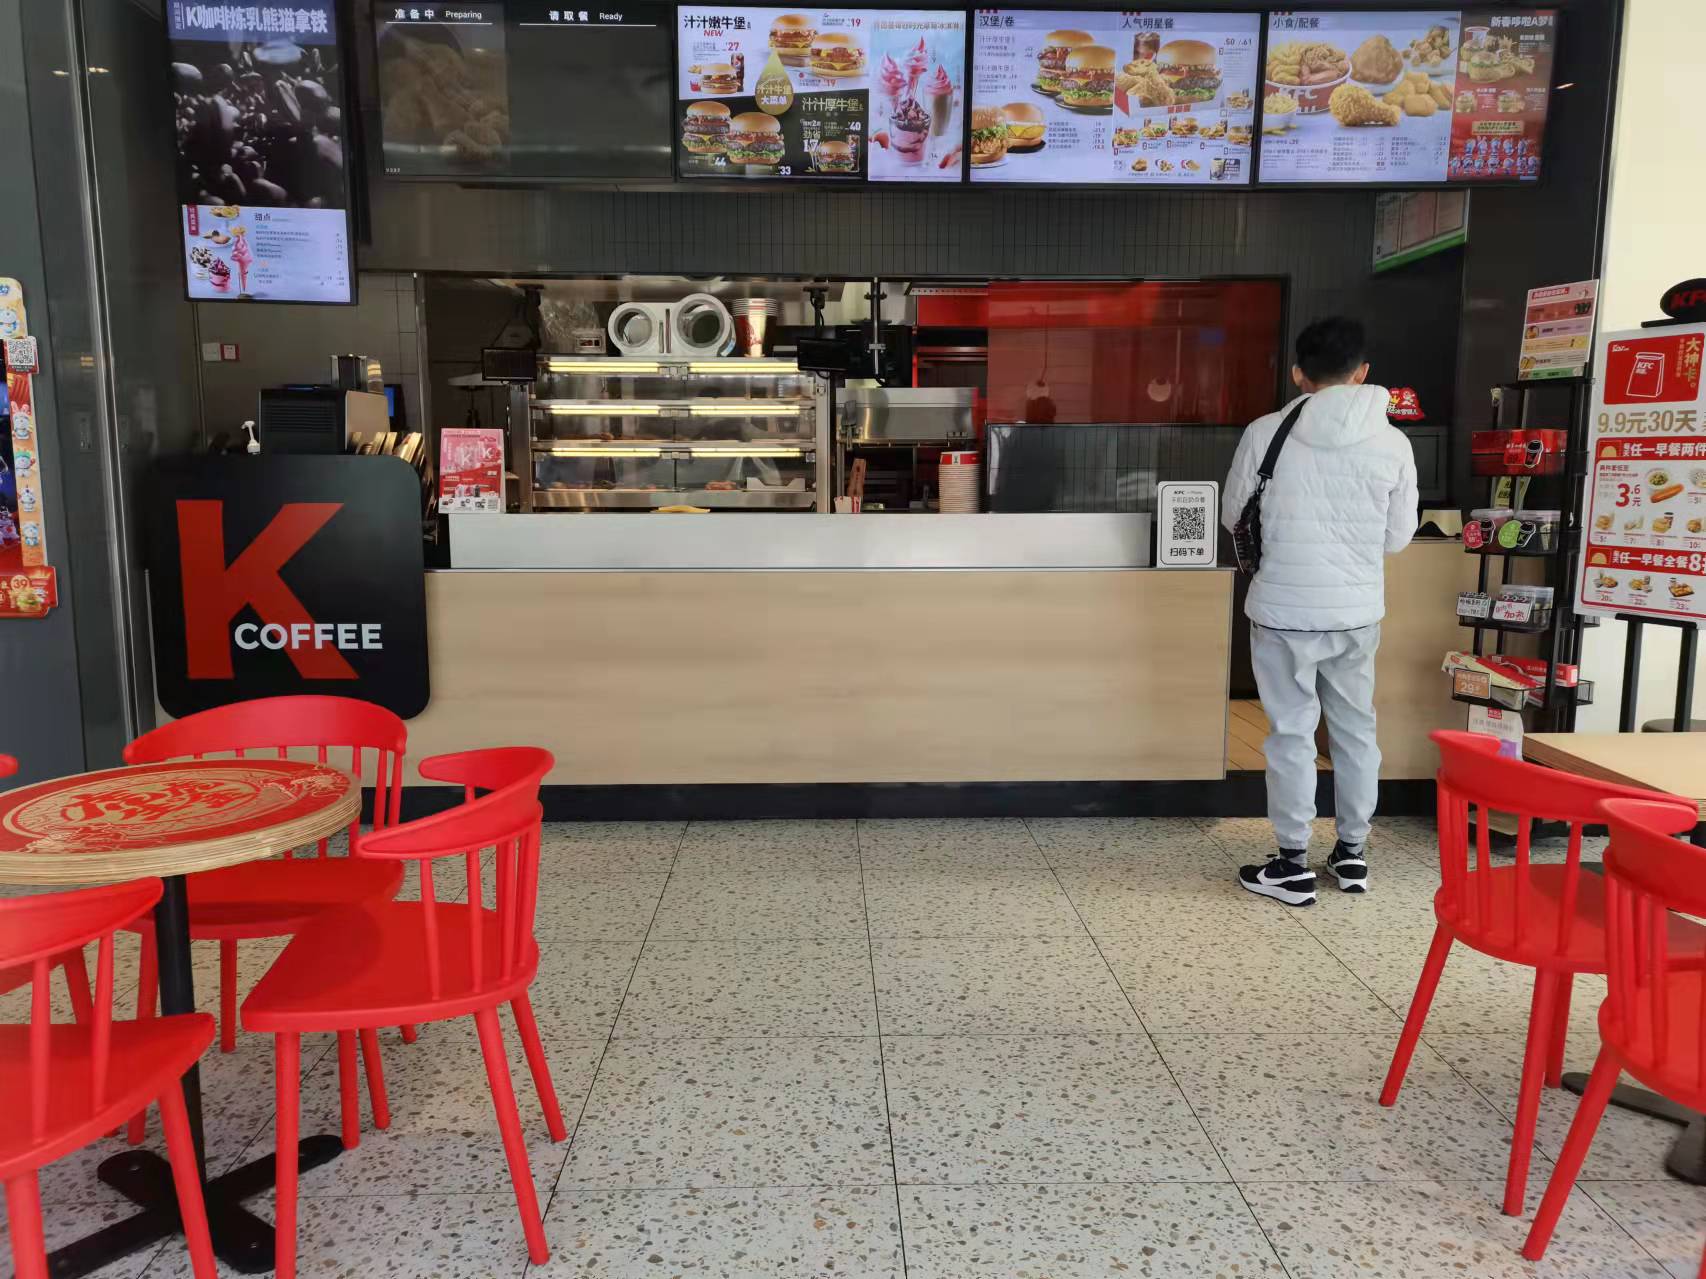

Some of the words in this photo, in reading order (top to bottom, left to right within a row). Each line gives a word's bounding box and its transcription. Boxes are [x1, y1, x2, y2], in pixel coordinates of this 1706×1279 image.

[186, 5, 328, 33] K咖啡炼乳熊猫拿铁
[395, 9, 434, 19] 准备中
[445, 10, 482, 20] Preparing
[549, 10, 588, 21] 请取餐
[599, 12, 623, 21] Ready
[684, 15, 746, 30] 汁汁嫩牛堡
[979, 16, 1014, 26] 汉堡/卷
[1122, 18, 1174, 29] 人气明星餐
[1273, 18, 1319, 29] 小食/配餐
[704, 29, 724, 37] NEW
[728, 42, 740, 51] 27
[802, 98, 858, 112] 汁汁厚牛堡
[780, 166, 791, 175] 33
[1637, 361, 1654, 369] KFC
[1597, 410, 1697, 434] 9.9元30天
[1170, 547, 1204, 556] 扫码下单
[13, 579, 27, 589] 39
[176, 499, 360, 680] K
[234, 623, 383, 650] COFFEE
